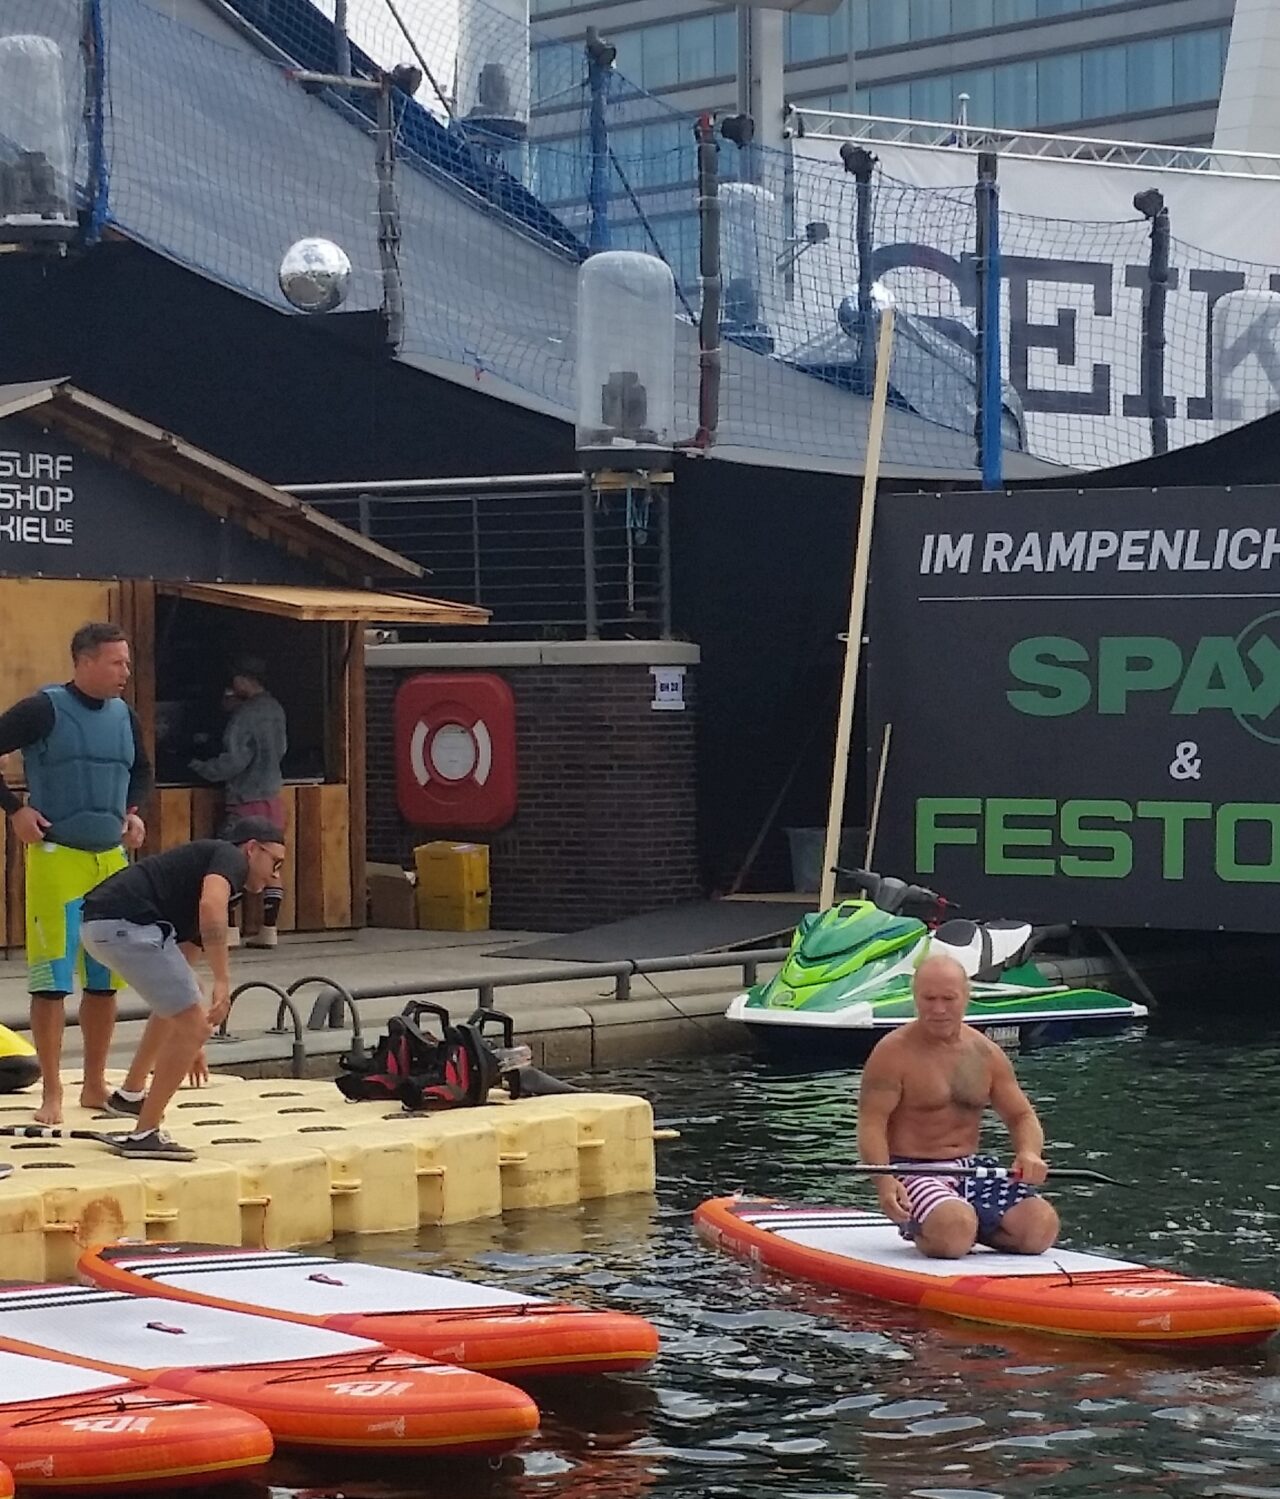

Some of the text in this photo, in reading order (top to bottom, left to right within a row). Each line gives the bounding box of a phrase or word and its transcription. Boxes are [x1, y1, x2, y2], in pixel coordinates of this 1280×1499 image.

[0, 450, 73, 480] SURF
[0, 483, 74, 512] SHOP
[919, 533, 973, 574] IM
[1169, 741, 1201, 780] &
